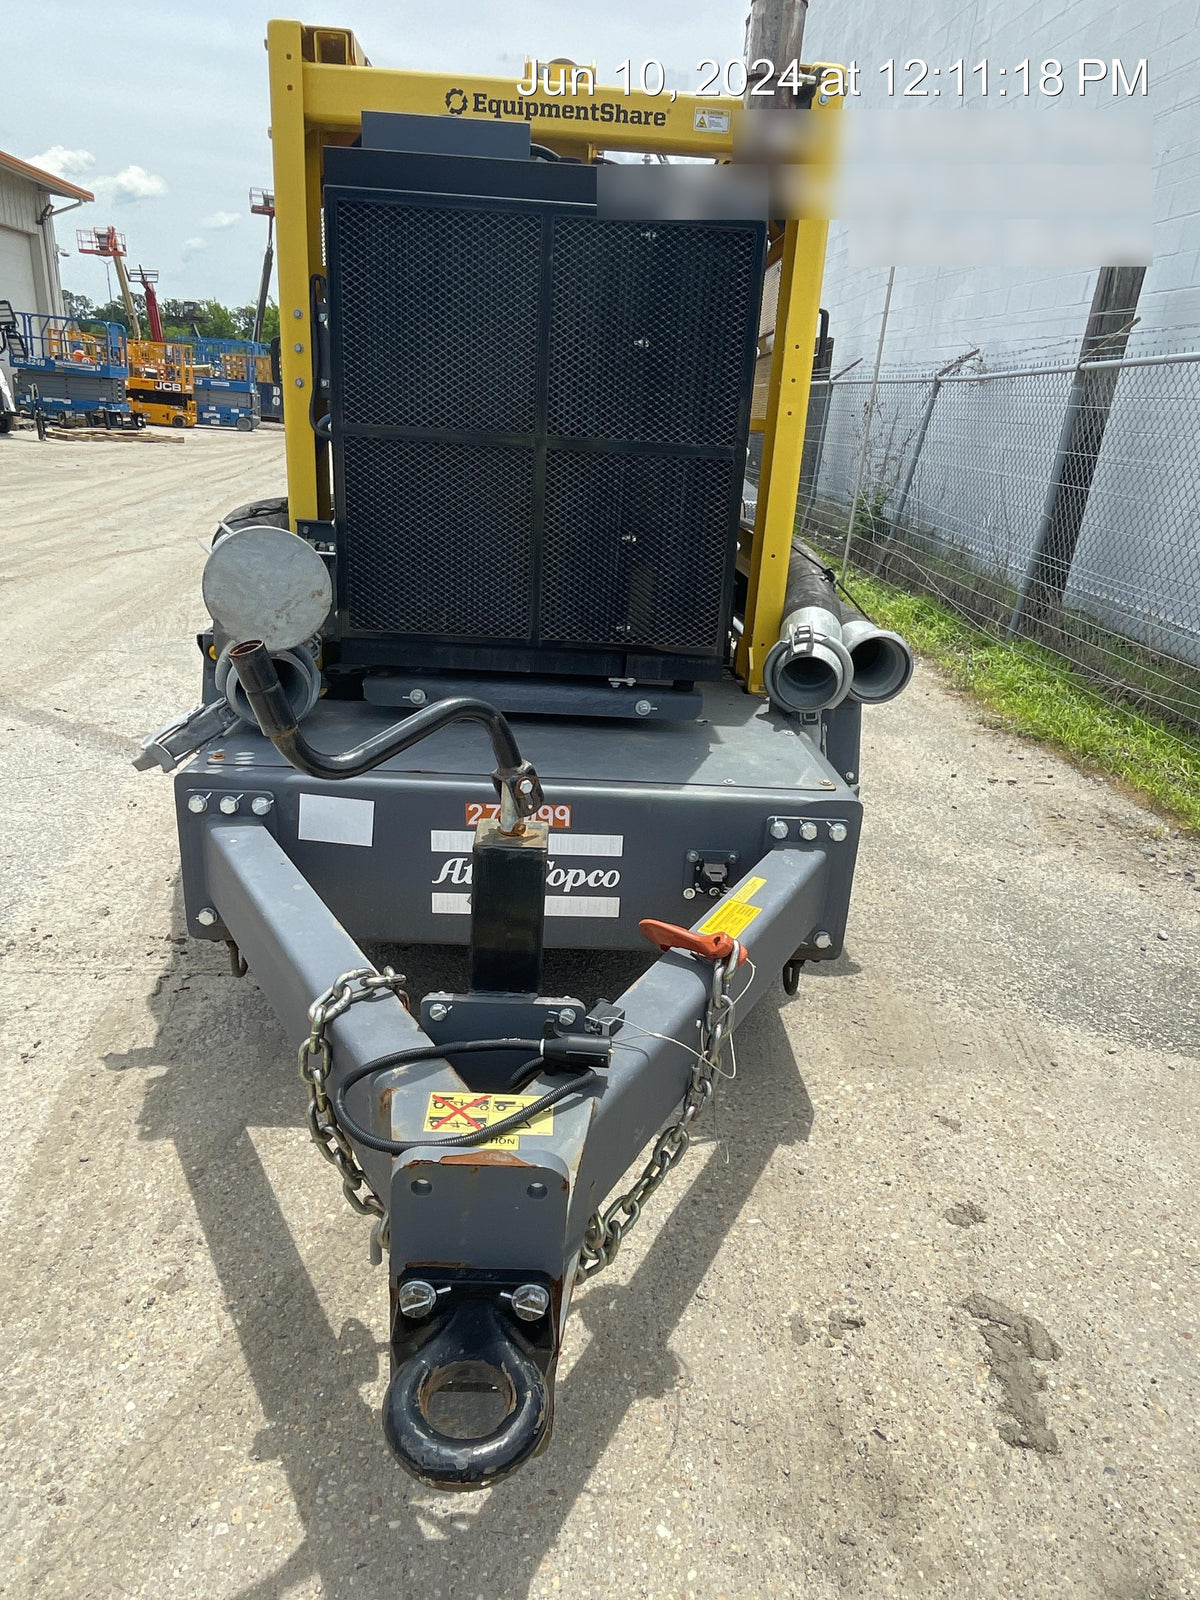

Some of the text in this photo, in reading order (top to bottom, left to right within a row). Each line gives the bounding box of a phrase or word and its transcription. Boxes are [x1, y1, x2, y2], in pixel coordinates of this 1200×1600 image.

[472, 92, 667, 127] EquipmentShare
[155, 382, 181, 392] JCB
[467, 803, 571, 827] 2799
[546, 861, 621, 893] opco
